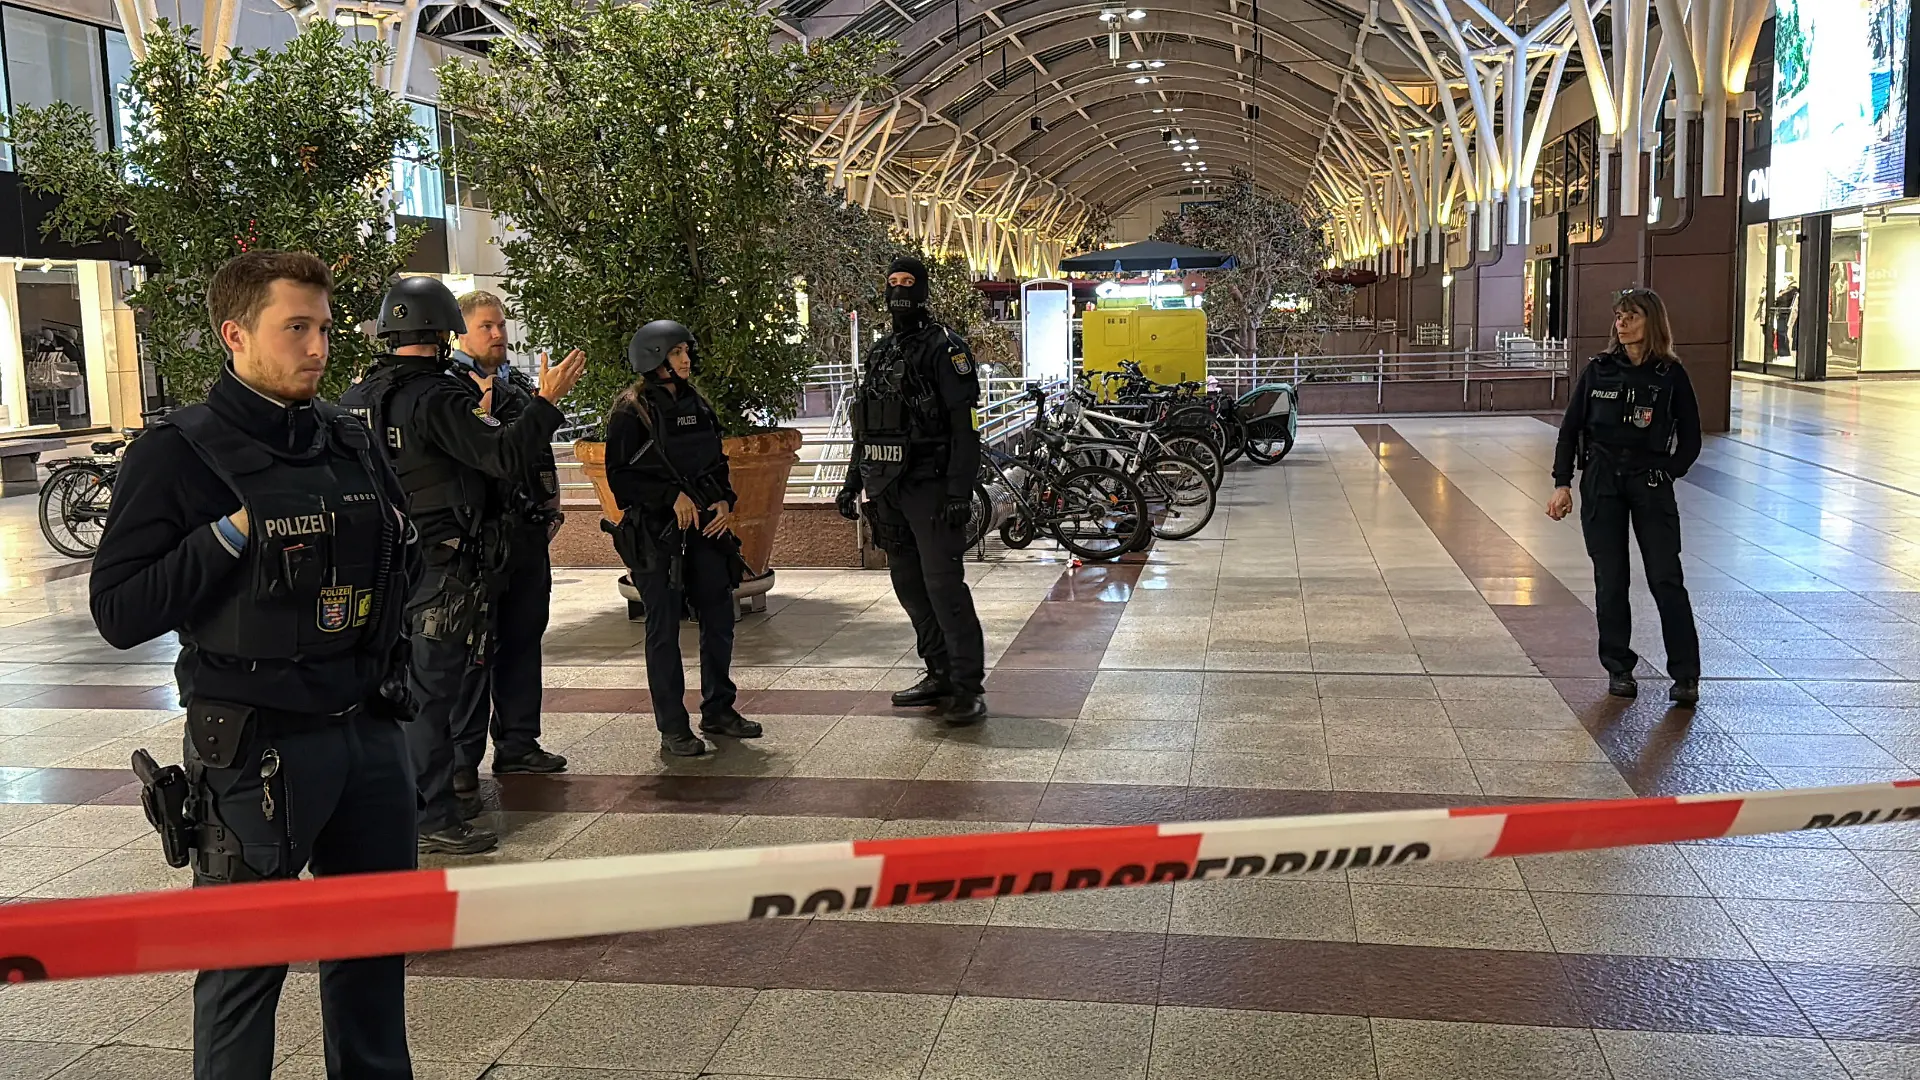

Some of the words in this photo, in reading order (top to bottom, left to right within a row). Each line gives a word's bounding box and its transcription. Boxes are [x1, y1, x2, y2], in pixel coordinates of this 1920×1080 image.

[890, 300, 911, 308] POLIZEI
[1591, 389, 1619, 399] POLIZEI
[677, 415, 697, 426] POLIZEI
[864, 444, 903, 462] POLIZEI
[265, 514, 326, 538] POLIZEI
[320, 588, 350, 597] POLIZEI
